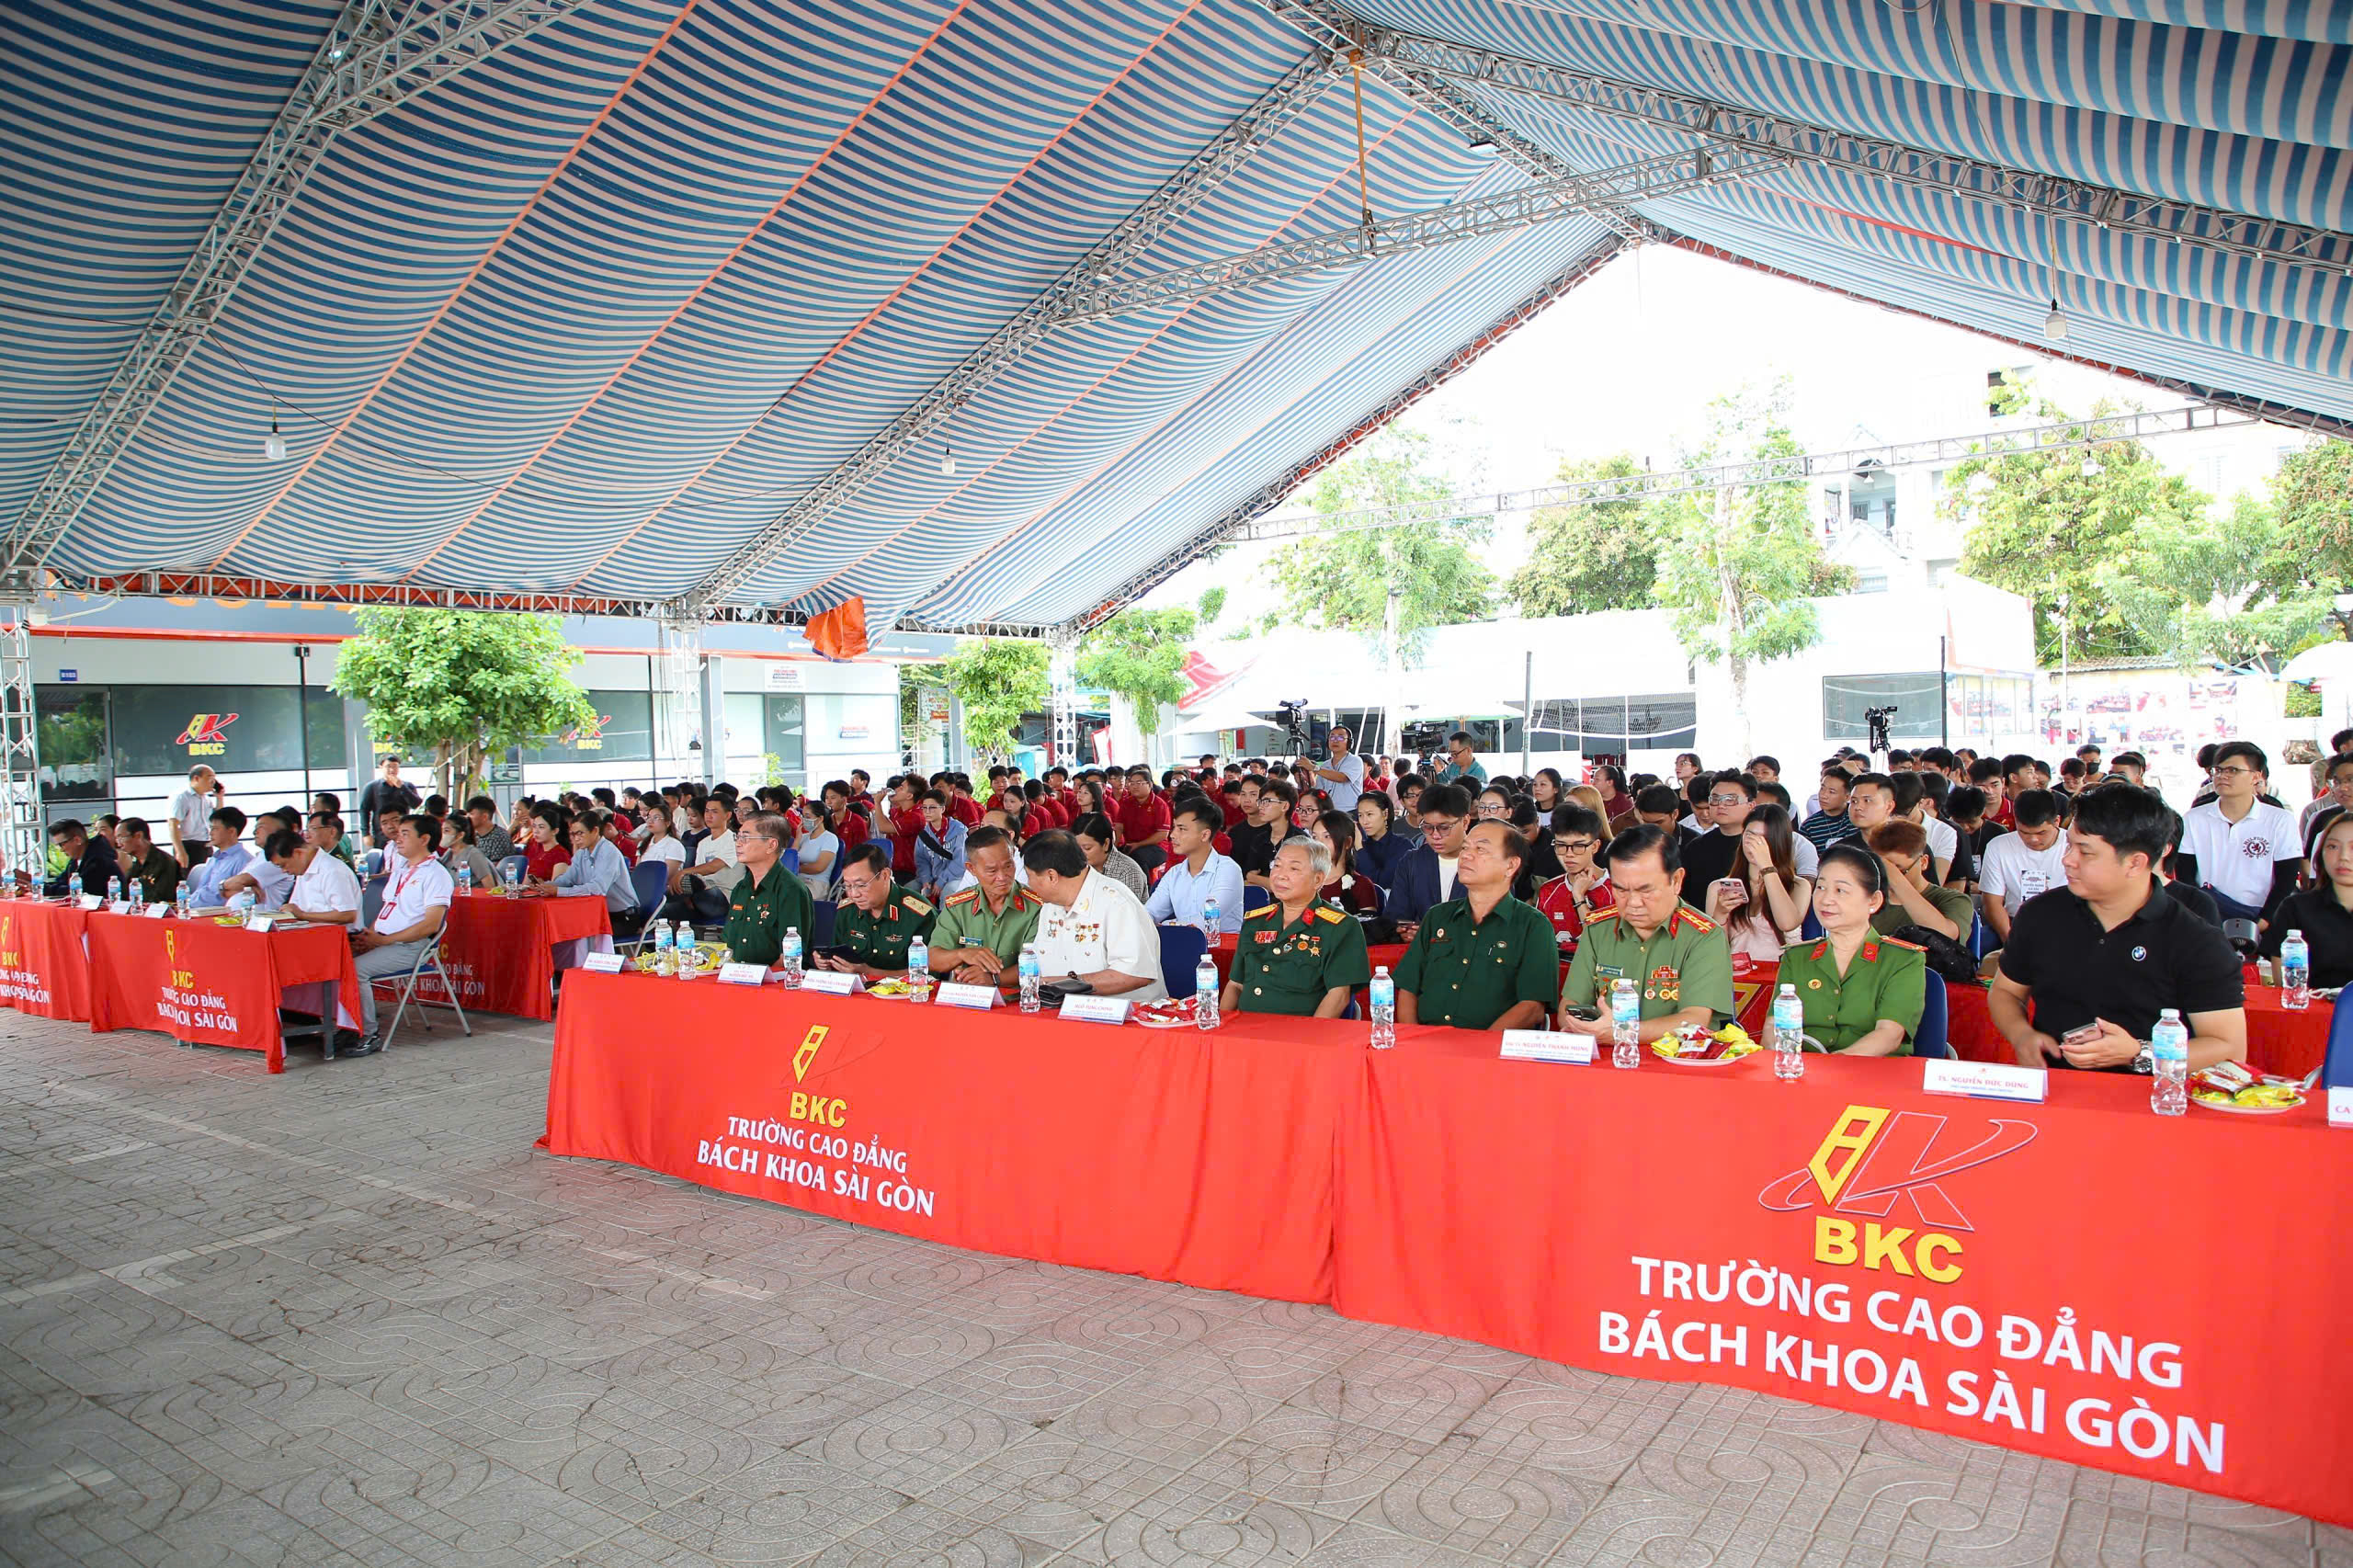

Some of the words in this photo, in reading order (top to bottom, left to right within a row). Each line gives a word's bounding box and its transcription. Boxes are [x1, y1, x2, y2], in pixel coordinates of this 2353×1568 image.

[188, 743, 225, 756] BKC
[194, 1007, 214, 1028] SÀI
[217, 1011, 238, 1032] GÒN
[790, 1091, 847, 1128] BKC
[698, 1136, 758, 1174] BÁCH
[765, 1153, 826, 1191] KHOA
[833, 1165, 870, 1201] SÀI
[876, 1176, 935, 1217] GÒN
[728, 1116, 804, 1150] TRƯỜNG
[809, 1132, 847, 1159] CAO
[852, 1133, 907, 1174] ĐẲNG
[1814, 1215, 1963, 1283] BKC
[1631, 1256, 1851, 1324] TRƯỜNG
[1866, 1290, 1984, 1348] CAO
[1996, 1306, 2182, 1388] ĐẲNG
[1598, 1310, 1747, 1366] BÁCH
[1766, 1331, 1928, 1406] KHOA
[1946, 1366, 2045, 1434] SÀI
[2065, 1396, 2224, 1474] GÒN
